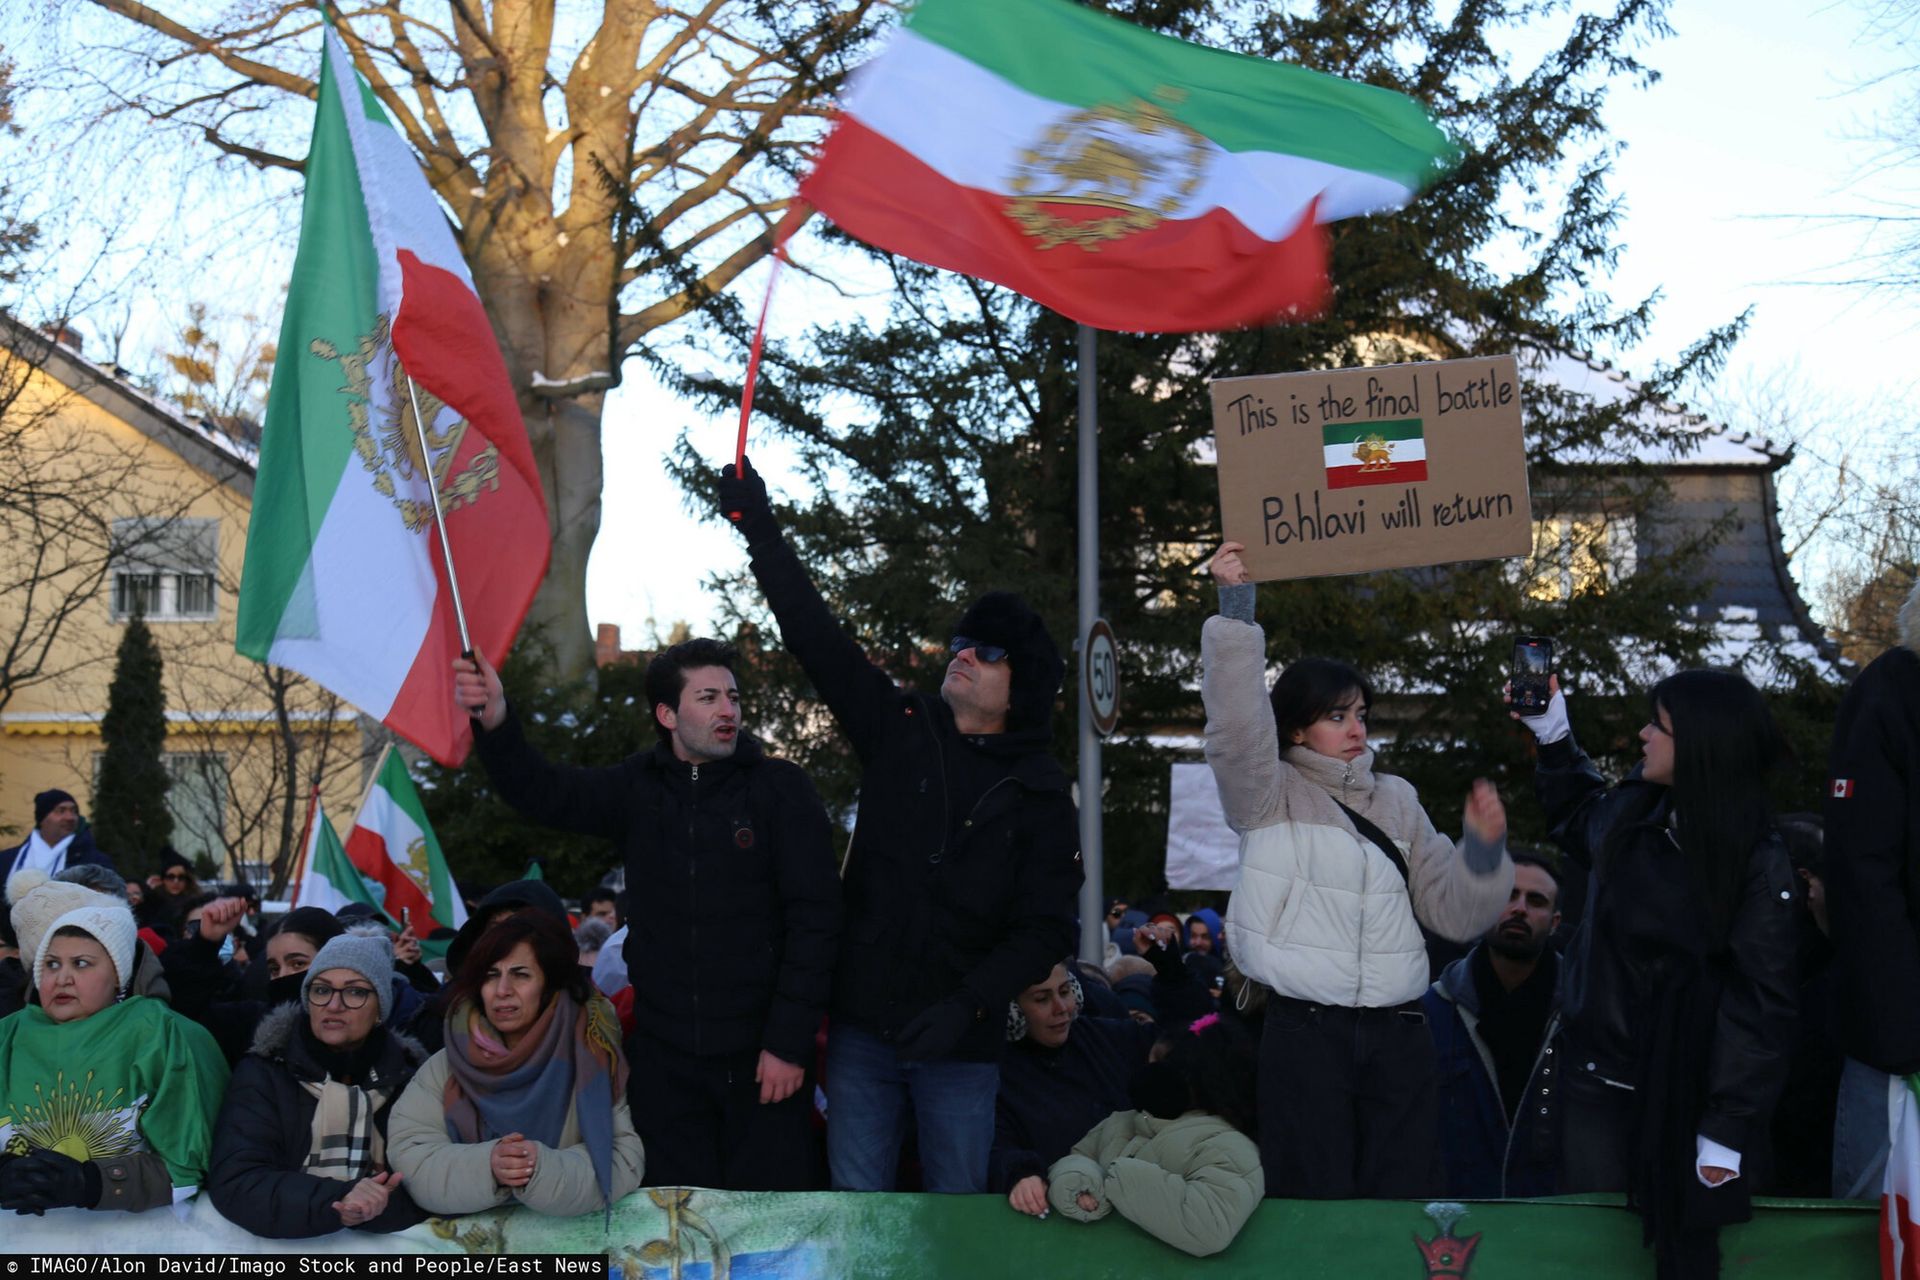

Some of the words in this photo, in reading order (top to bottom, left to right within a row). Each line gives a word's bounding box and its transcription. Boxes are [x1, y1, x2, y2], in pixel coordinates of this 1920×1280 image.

[1227, 394, 1278, 435] This
[1291, 394, 1310, 424] is
[1318, 384, 1357, 421] the
[1366, 374, 1420, 418] final
[1436, 368, 1513, 416] battle
[1262, 490, 1366, 546] Pahlavi
[1381, 487, 1421, 530] will
[1432, 492, 1513, 527] return
[1093, 651, 1113, 701] 50
